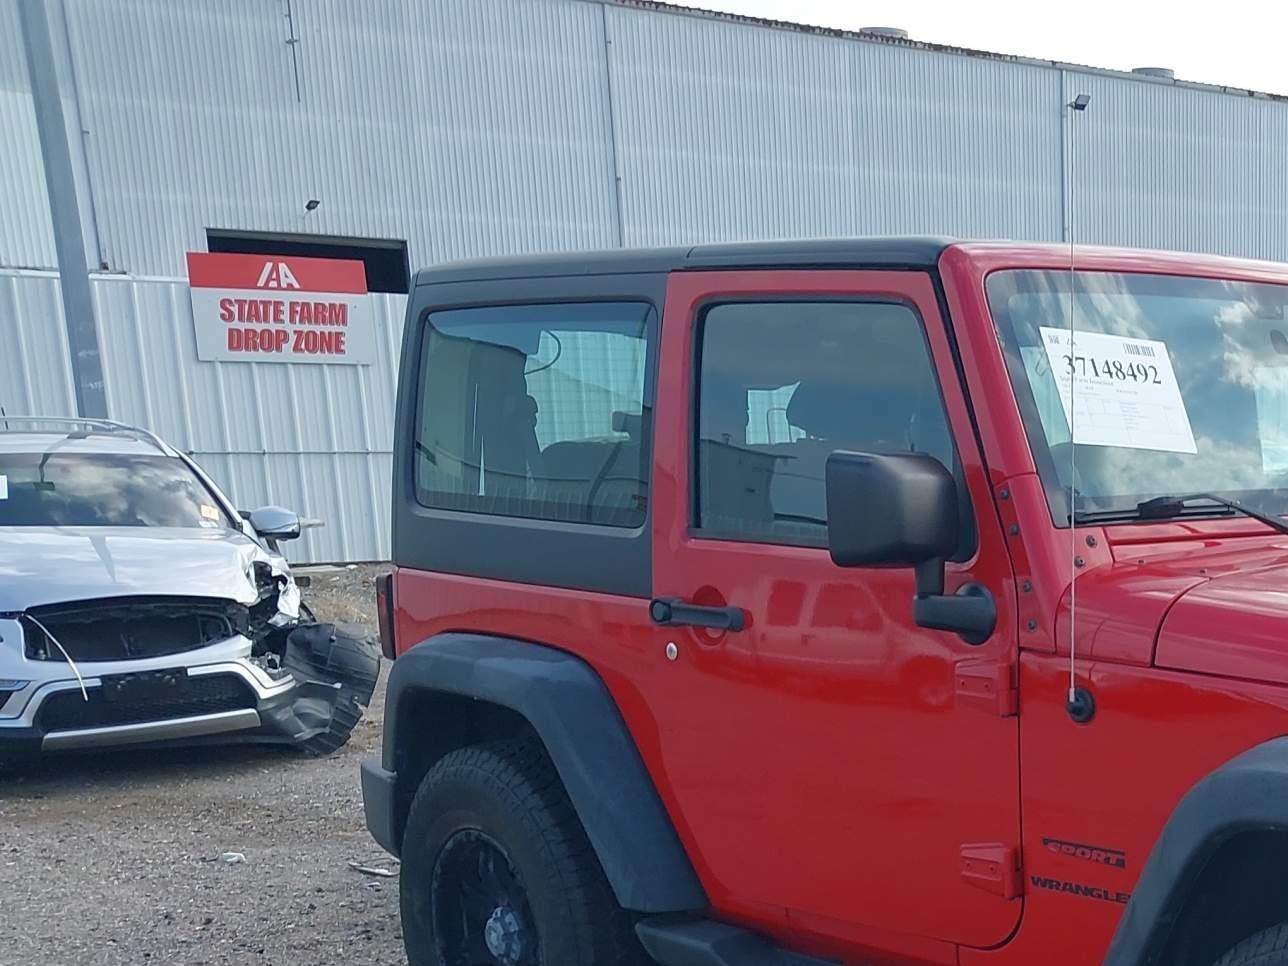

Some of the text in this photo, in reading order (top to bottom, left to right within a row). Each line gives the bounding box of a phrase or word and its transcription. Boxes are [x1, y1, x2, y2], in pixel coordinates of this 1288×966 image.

[219, 297, 348, 327] STATE FARM
[227, 327, 346, 355] DROP ZONE
[1062, 353, 1163, 385] 37148492
[1045, 840, 1125, 868] SPORT
[1031, 876, 1132, 904] WRANGLE
